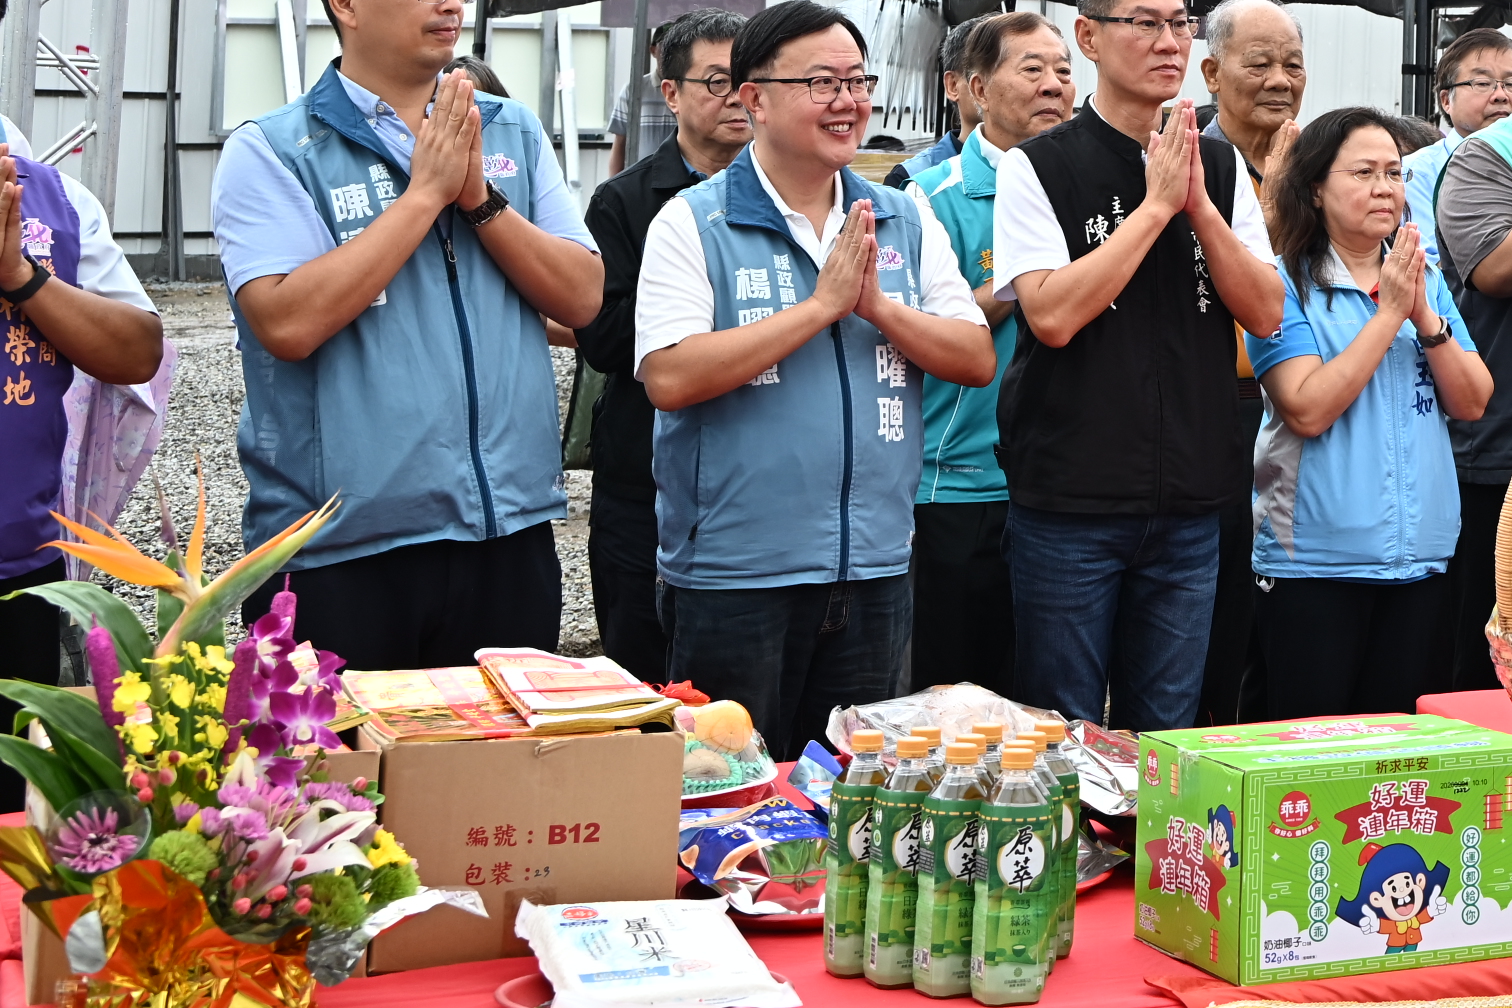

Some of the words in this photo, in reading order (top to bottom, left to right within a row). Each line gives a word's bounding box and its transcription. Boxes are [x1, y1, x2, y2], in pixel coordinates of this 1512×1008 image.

[1375, 756, 1429, 774] 祈求平安
[1280, 799, 1309, 818] 乖乖
[1370, 780, 1429, 810] 好運
[465, 823, 534, 847] 編號：
[548, 822, 601, 845] B12
[1167, 817, 1206, 864] 好運
[1358, 807, 1437, 841] 連年箱
[465, 861, 531, 886] 包裝：
[1006, 826, 1034, 894] 原萃
[1462, 830, 1479, 924] 好運都給你
[1160, 857, 1211, 913] 連年箱
[1311, 844, 1328, 940] 拜拜用乖乖
